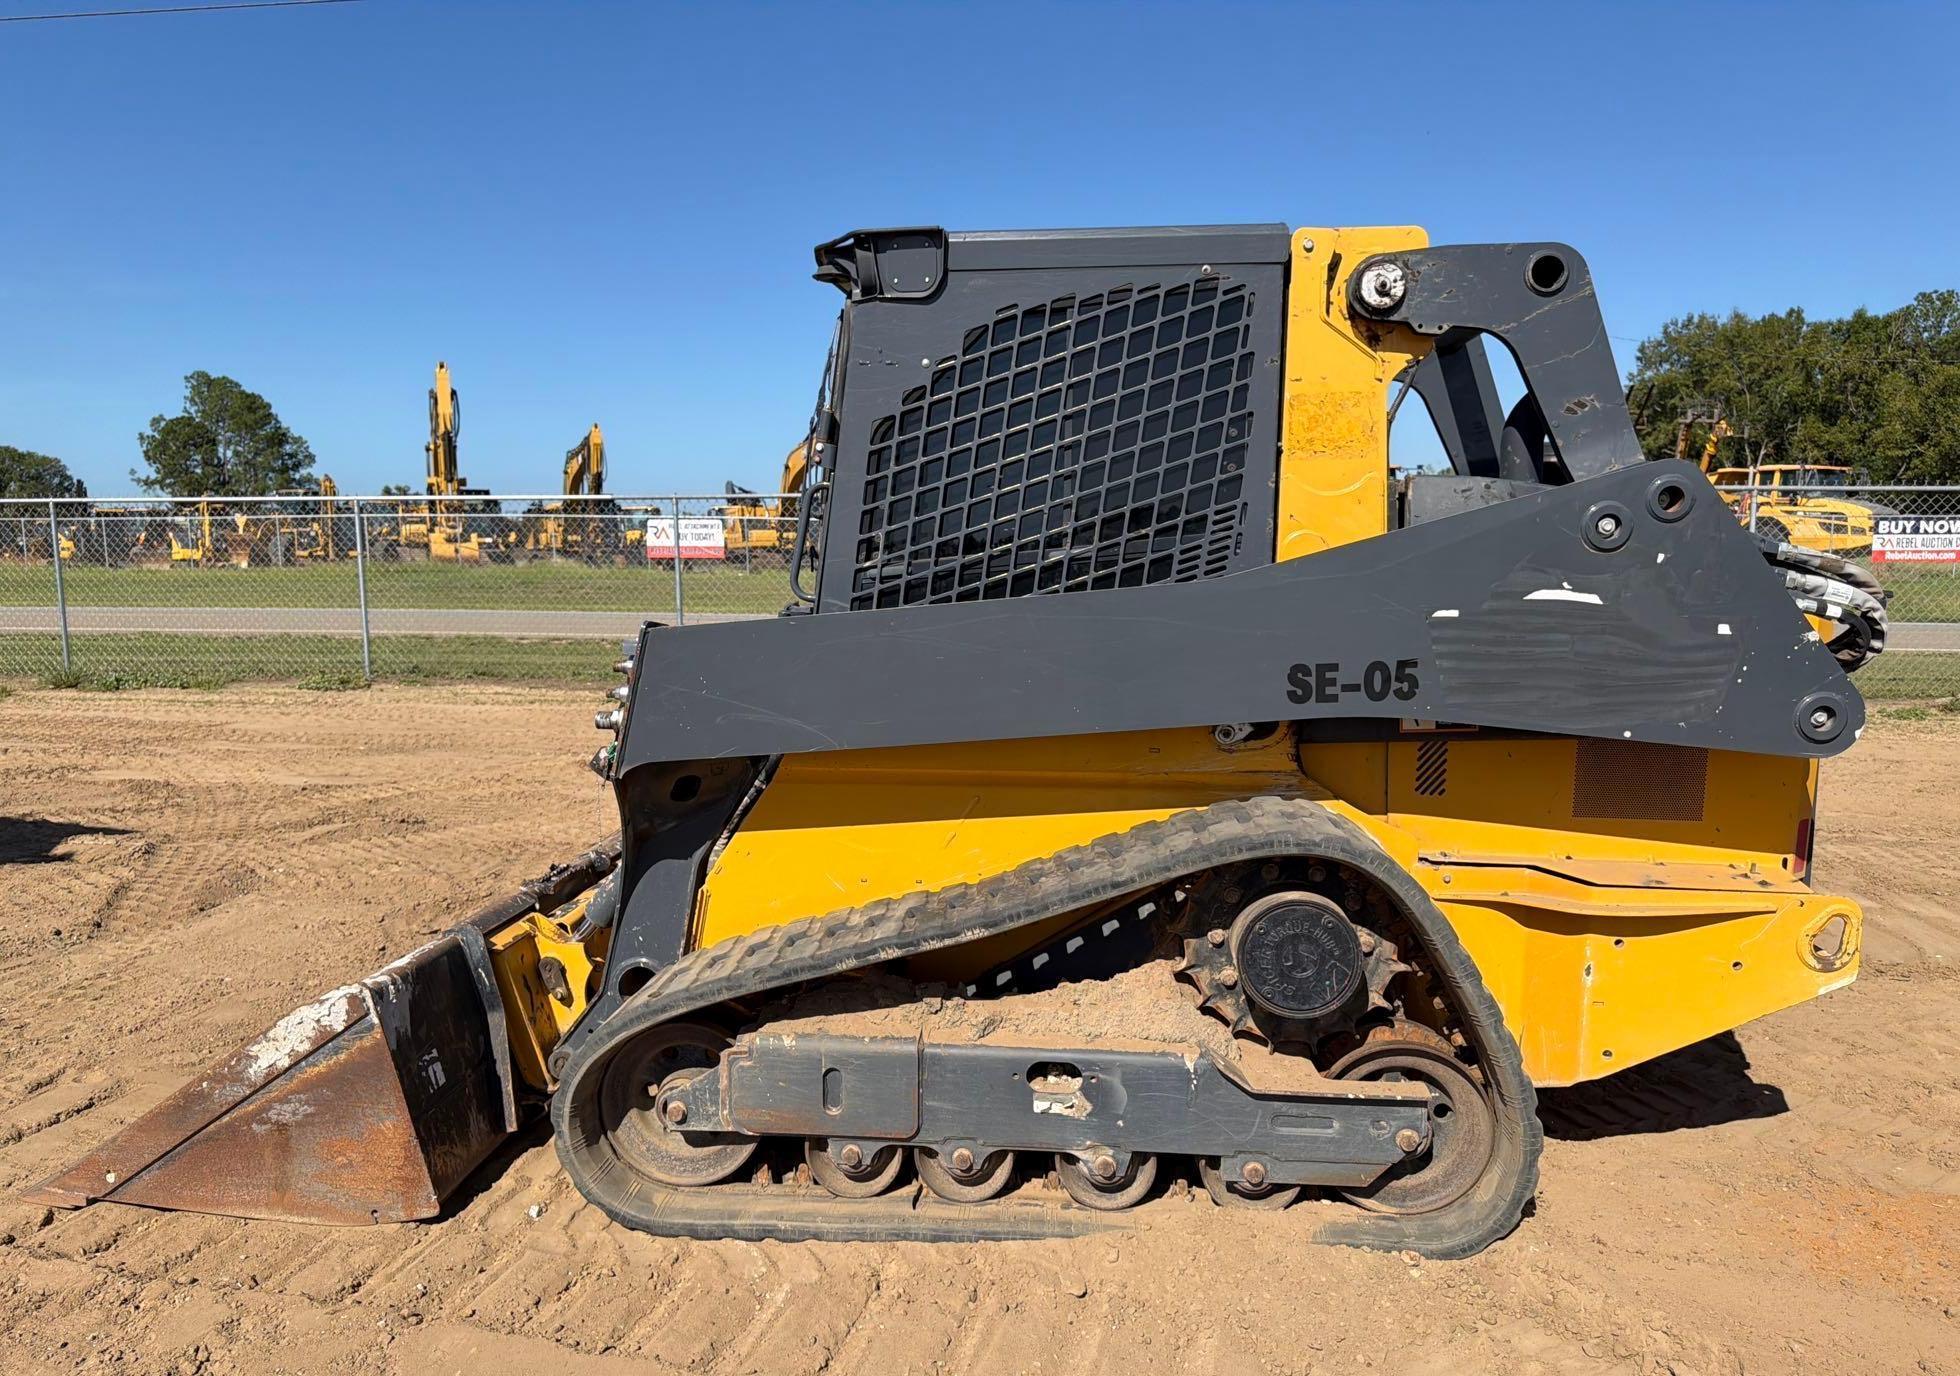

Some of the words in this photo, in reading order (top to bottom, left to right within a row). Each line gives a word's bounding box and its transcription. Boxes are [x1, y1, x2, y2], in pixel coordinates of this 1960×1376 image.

[1878, 520, 1915, 534] BUY
[1896, 538, 1917, 549] REBEL
[1921, 537, 1953, 549] AUCTION
[1885, 551, 1956, 560] RebelAuction.com
[1286, 658, 1419, 704] SE-05
